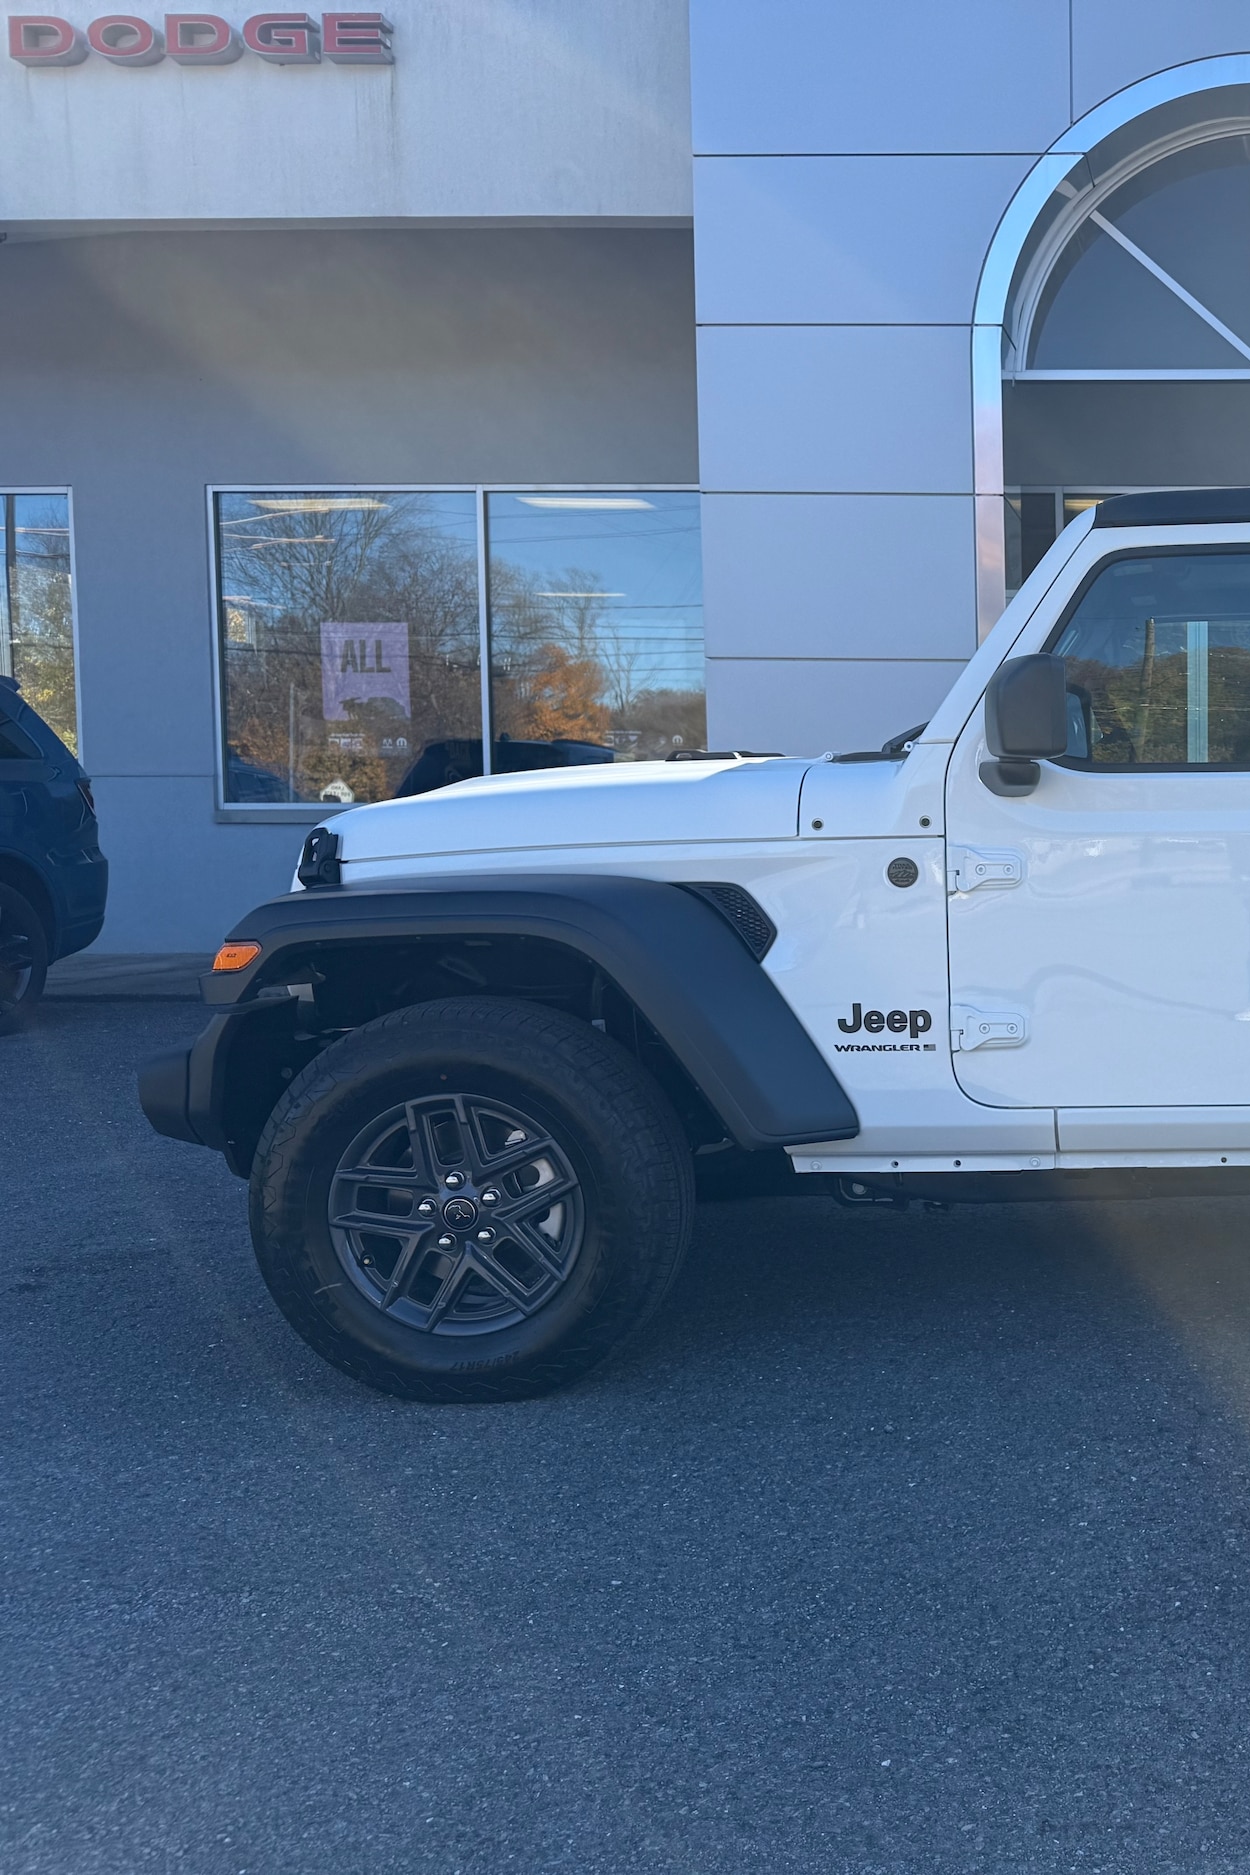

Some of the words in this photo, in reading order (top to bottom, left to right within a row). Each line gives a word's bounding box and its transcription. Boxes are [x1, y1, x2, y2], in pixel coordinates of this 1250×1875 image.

[8, 13, 386, 62] DODGE
[341, 639, 391, 673] ALL
[837, 1003, 932, 1039] Jeep
[834, 1044, 920, 1052] WRANGLER
